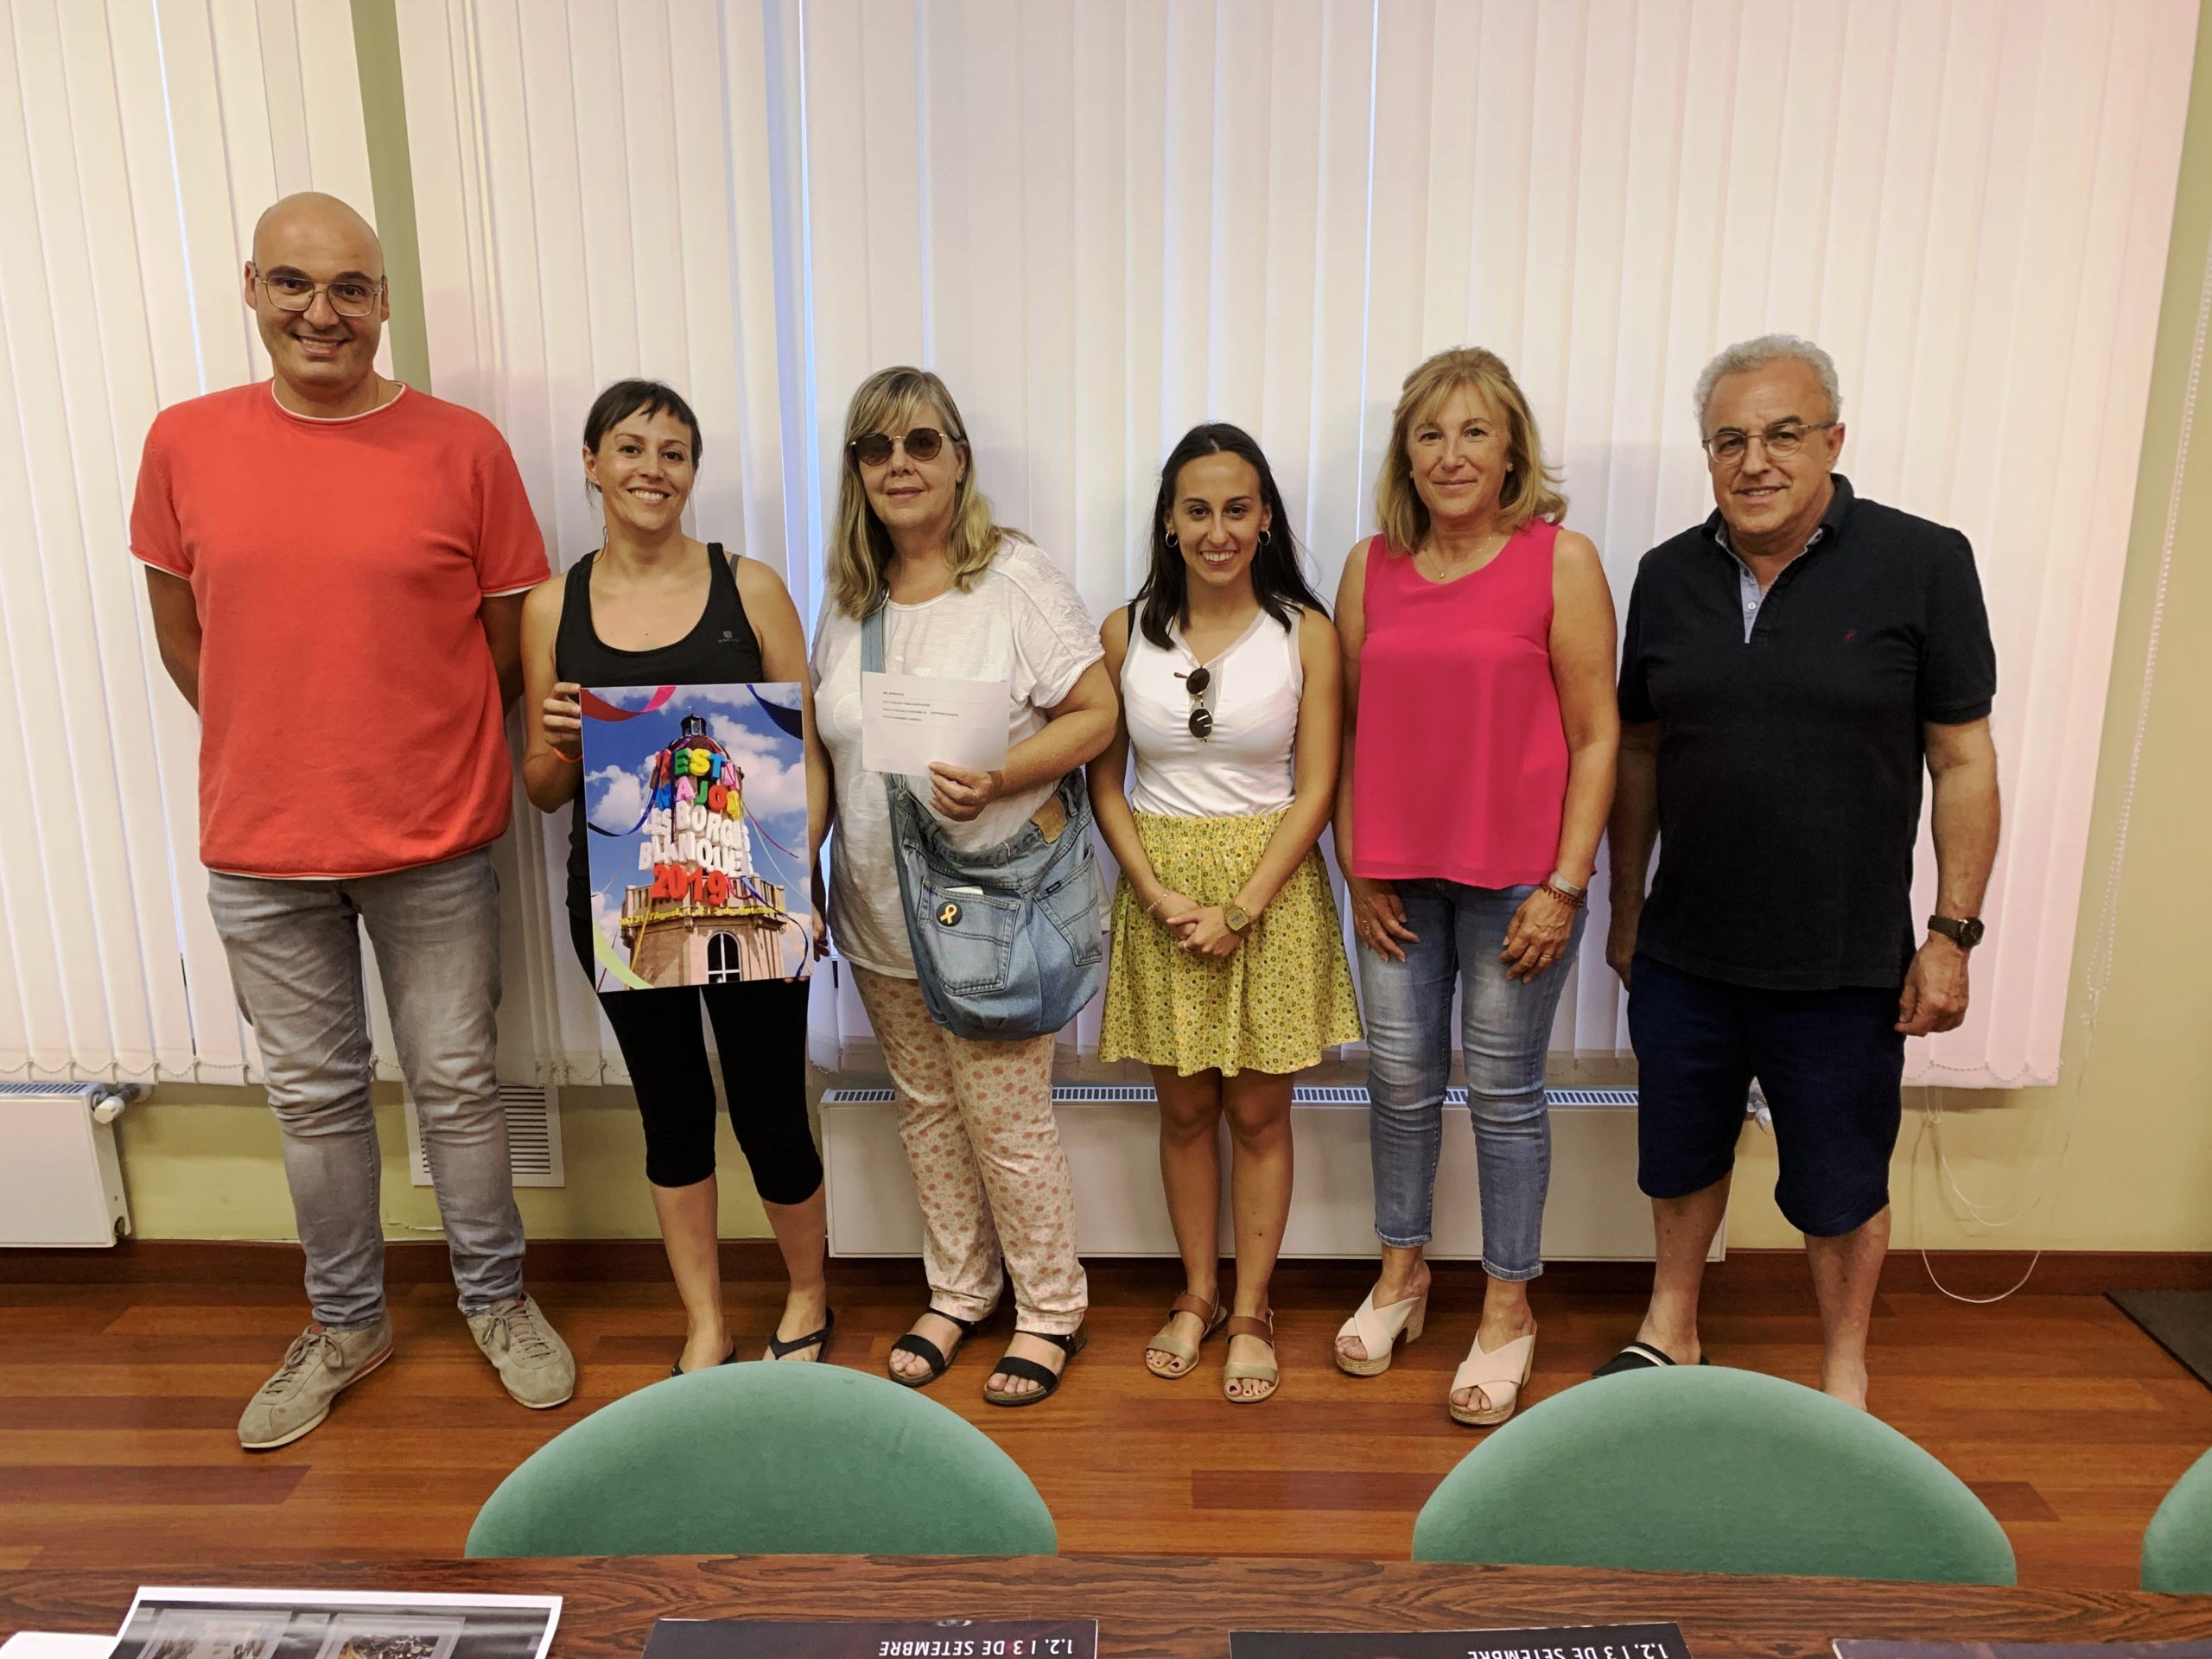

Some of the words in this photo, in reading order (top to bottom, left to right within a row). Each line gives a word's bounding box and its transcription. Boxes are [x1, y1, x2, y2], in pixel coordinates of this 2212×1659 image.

[640, 807, 671, 837] LES
[649, 863, 727, 906] 2019
[879, 1641, 975, 1656] SETEMBRE
[982, 1641, 1005, 1656] DE
[1013, 1640, 1024, 1656] 3
[1031, 1640, 1036, 1655] I
[1571, 1647, 1597, 1659] DE
[1604, 1646, 1614, 1659] 3
